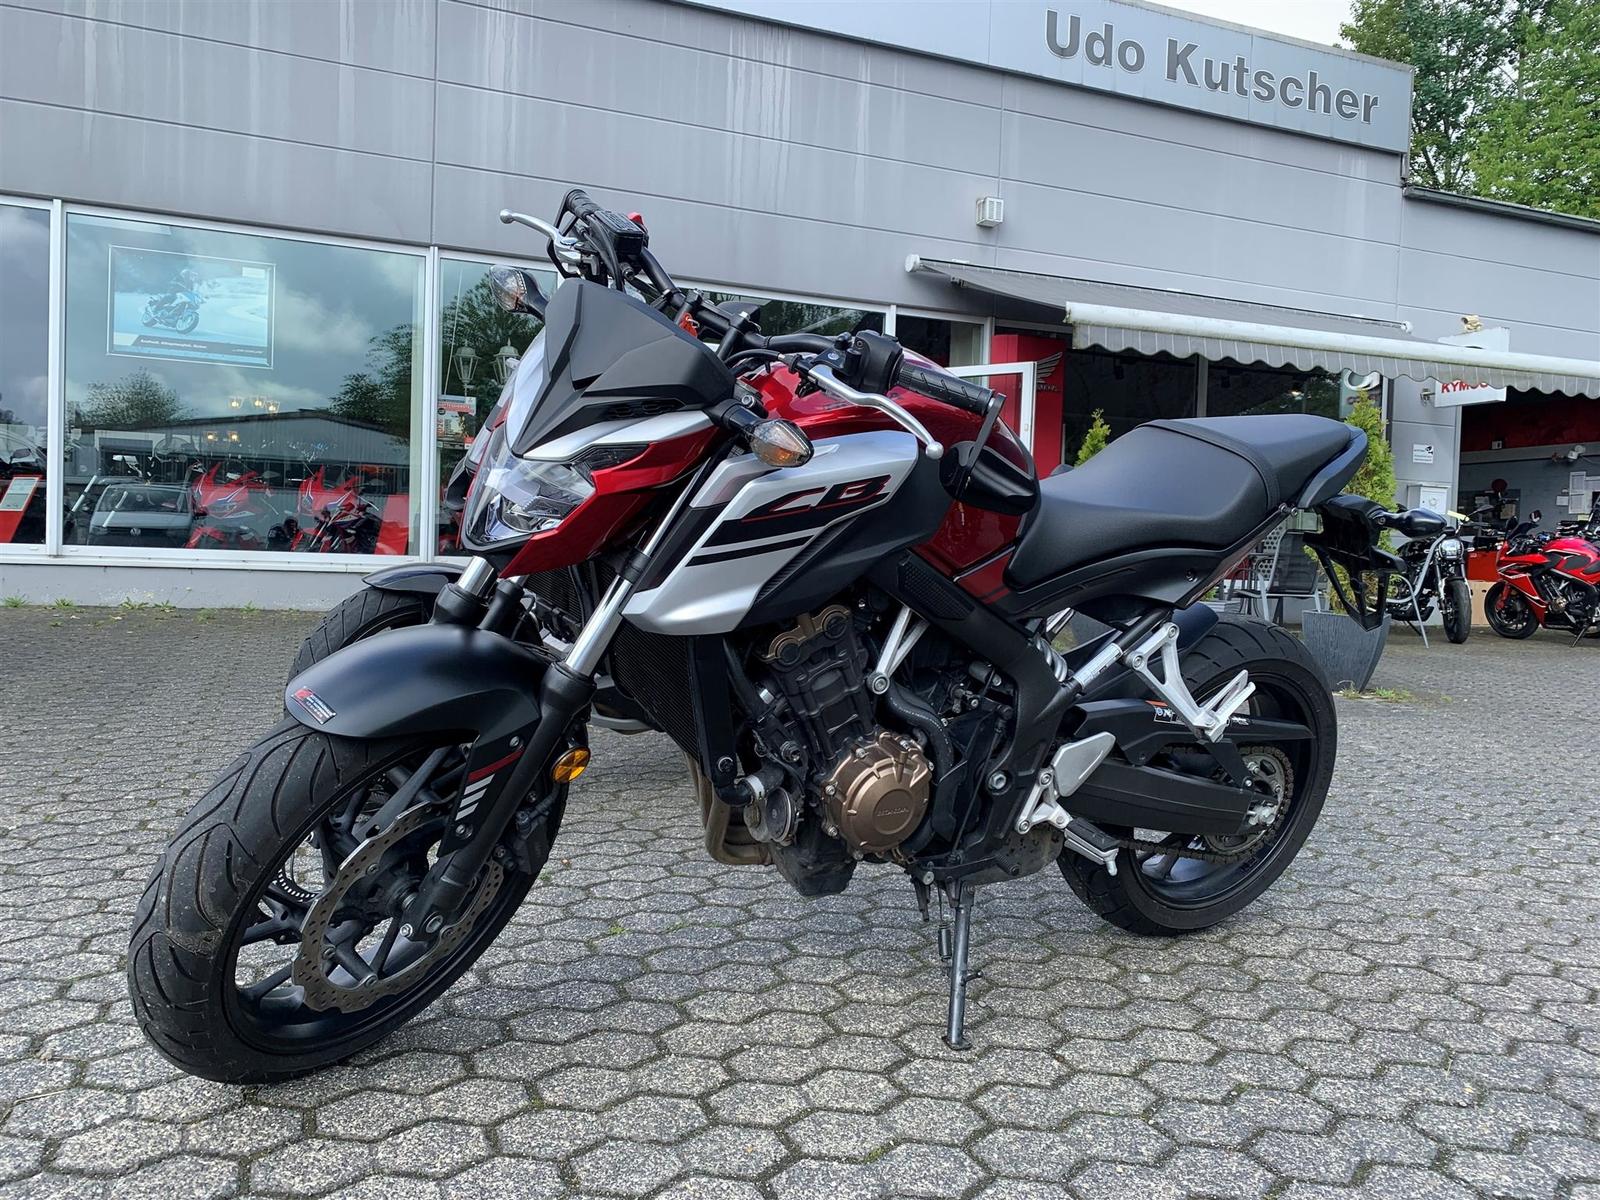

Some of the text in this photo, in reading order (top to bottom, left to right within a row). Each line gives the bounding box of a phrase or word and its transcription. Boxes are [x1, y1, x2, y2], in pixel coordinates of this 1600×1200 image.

[1045, 9, 1380, 124] Udo Kutscher
[741, 474, 892, 523] CB
